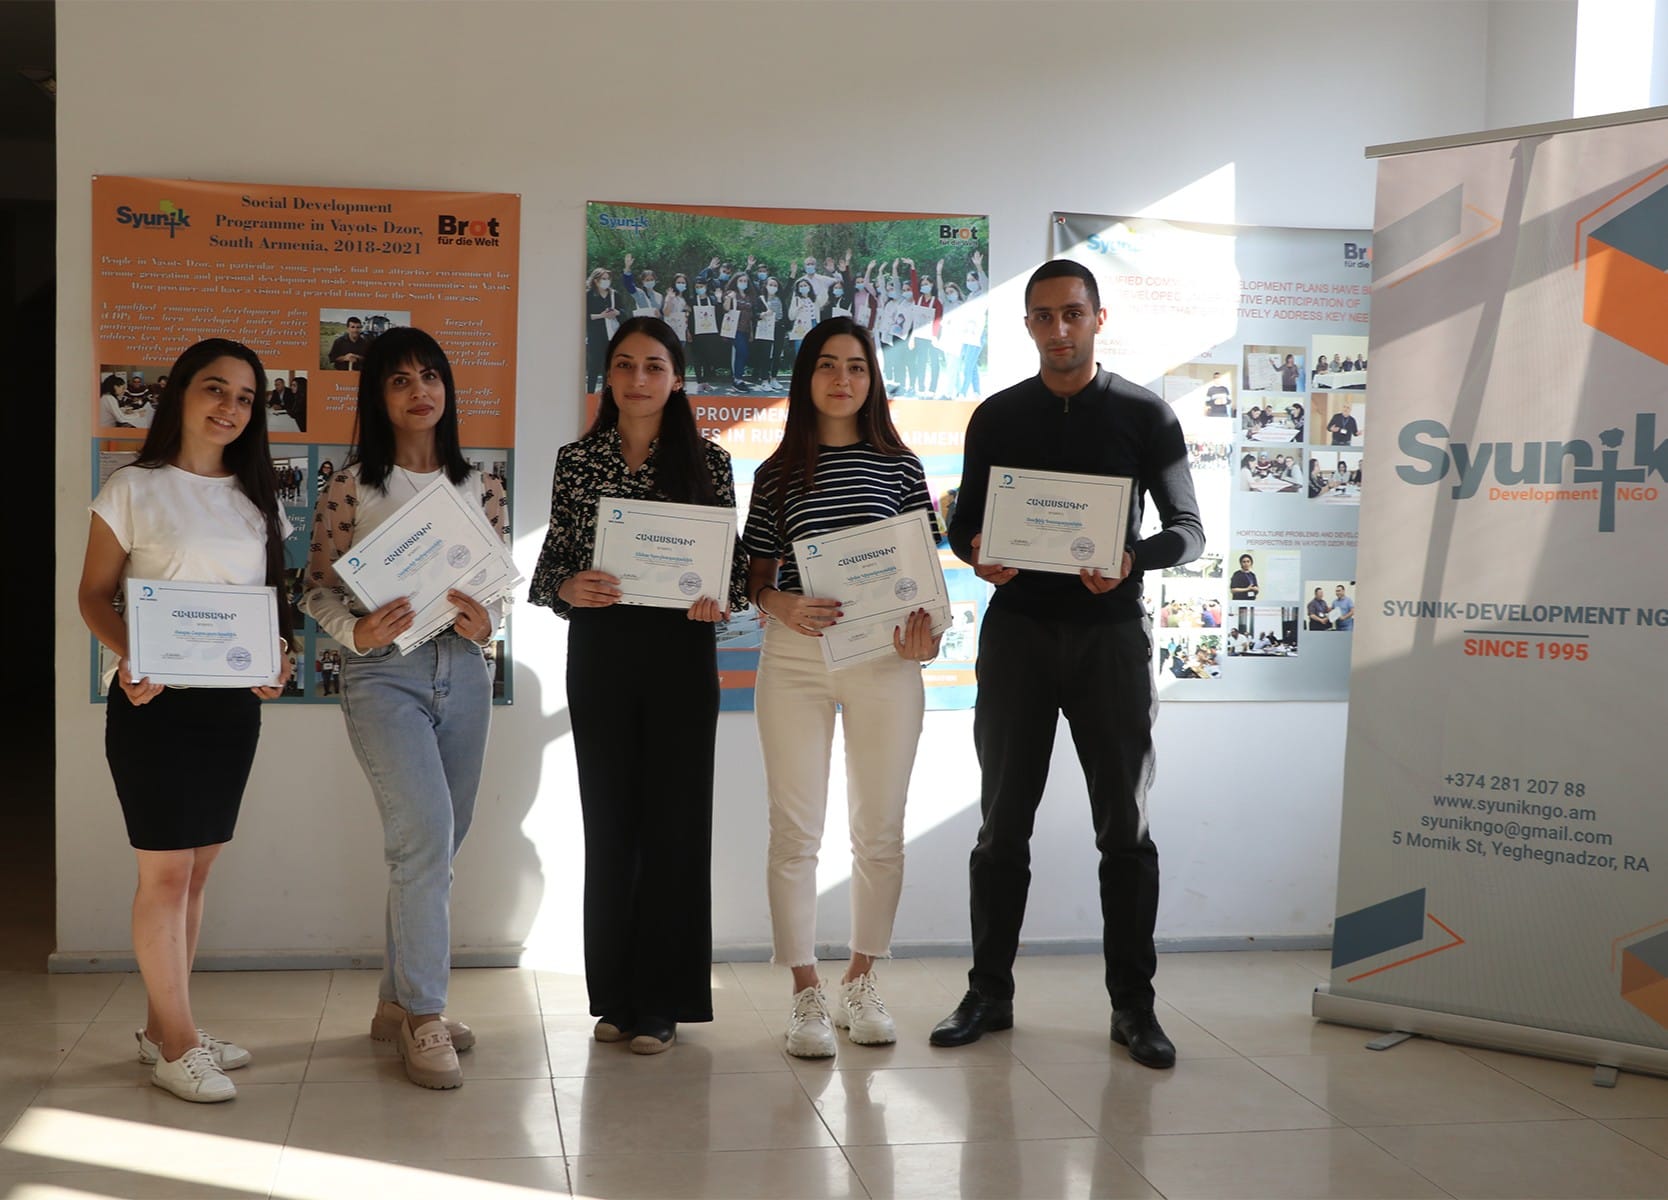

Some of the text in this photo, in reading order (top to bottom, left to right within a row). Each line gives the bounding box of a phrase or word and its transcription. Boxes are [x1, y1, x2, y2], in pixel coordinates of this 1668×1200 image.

[241, 195, 392, 215] Social Development
[116, 205, 190, 239] Syunik
[215, 214, 423, 236] Programme in Vayots Dzor,
[438, 215, 500, 237] Brot
[599, 213, 650, 236] Syunik
[438, 237, 500, 247] für die Welt
[938, 224, 979, 241] Brot
[209, 235, 253, 249] South
[334, 239, 421, 255] 2018-2021
[101, 255, 131, 266] People
[137, 257, 147, 265] in
[151, 258, 182, 267] Vayots
[216, 261, 225, 269] in
[229, 261, 274, 271] particular
[388, 268, 431, 276] attractive
[496, 270, 510, 279] for
[131, 281, 153, 290] Dzor
[157, 283, 197, 293] province
[201, 284, 217, 293] and
[220, 285, 242, 294] have
[253, 286, 280, 295] vision
[283, 287, 292, 295] of
[303, 289, 342, 298] peaceful
[345, 289, 371, 298] future
[375, 291, 387, 299] for
[408, 292, 435, 301] South
[139, 270, 189, 281] generation
[194, 272, 210, 281] and
[215, 274, 254, 283] personal
[258, 274, 317, 285] development
[351, 279, 404, 289] empowered
[482, 283, 510, 292] Vayots
[1295, 283, 1329, 295] PLANS
[1332, 284, 1360, 295] HAVE
[114, 302, 156, 312] qualified
[222, 306, 281, 317] development
[1265, 296, 1344, 307] PARTICIPATION
[1346, 298, 1361, 308] OF
[191, 315, 239, 325] developed
[445, 318, 484, 328] Targeted
[1274, 310, 1323, 321] ADDRESS
[1326, 312, 1345, 322] KEY
[1348, 313, 1369, 323] NEE
[100, 323, 160, 332] participation
[239, 327, 257, 335] that
[696, 406, 789, 424] PROVEMEN
[728, 428, 748, 443] IN
[751, 429, 785, 445] RUR
[903, 431, 967, 446] ARMENI
[1488, 487, 1659, 504] Development NGO
[1382, 600, 1668, 627] SYUNIK-DEVELOPMENT NG
[1463, 639, 1590, 662] SINCE 1995
[1443, 773, 1586, 798] +374 281 207 88
[1432, 793, 1597, 822] www.syunikngo.am
[1419, 814, 1613, 846] syunikngo@gmail.com
[1391, 831, 1650, 873] 5 Momik St, Yeghegnadzor, RA
